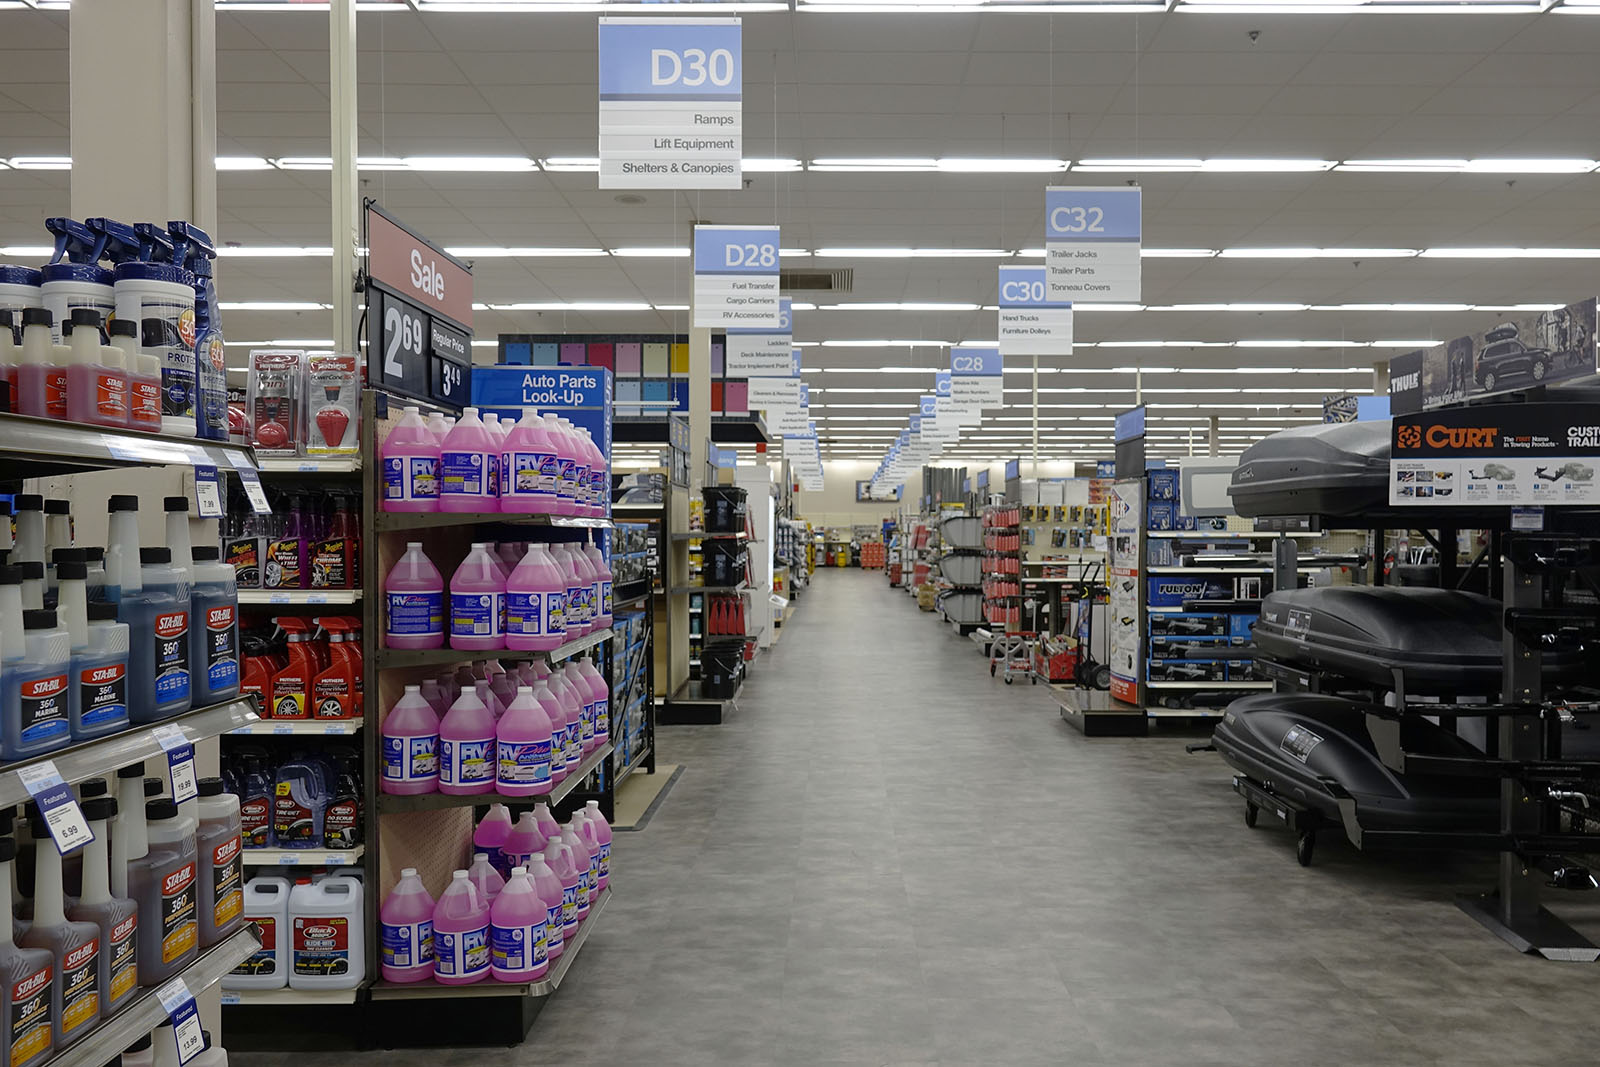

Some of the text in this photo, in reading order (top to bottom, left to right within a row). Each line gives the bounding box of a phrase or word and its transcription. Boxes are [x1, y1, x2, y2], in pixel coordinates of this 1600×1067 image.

[651, 49, 734, 86] D30
[694, 114, 734, 126] Ramps
[654, 139, 734, 150] Lift Equipment
[622, 163, 734, 175] Shelters & Canopies
[1051, 207, 1104, 232] C32
[725, 244, 775, 267] D28
[410, 249, 444, 301] Sale
[1051, 267, 1095, 275] Trailer Parts
[1002, 281, 1044, 301] C30
[726, 297, 747, 305] Cargo
[433, 329, 464, 353] Regular Price
[953, 357, 983, 372] C28
[522, 374, 596, 388] Auto Parts
[1391, 372, 1419, 393] THULE
[522, 389, 584, 406] Look-Up
[1425, 425, 1497, 448] CURT
[1567, 426, 1600, 437] CUST
[516, 455, 543, 470] RV
[1159, 584, 1202, 594] FULTON
[392, 596, 407, 605] RV
[159, 615, 184, 630] STA-BIL
[210, 608, 231, 622] STA-BIL
[215, 633, 227, 646] 360
[163, 641, 179, 655] 360
[92, 667, 117, 682] STA-BIL
[33, 679, 60, 694] STA-BIL
[99, 686, 112, 695] 360
[40, 698, 55, 709] 360
[94, 693, 116, 703] MARINE
[35, 706, 59, 718] MARINE
[412, 739, 434, 755] RV
[461, 744, 488, 760] RV
[499, 744, 521, 760] RV
[172, 750, 190, 760] Featured
[178, 780, 191, 791] 19.99
[43, 791, 68, 805] Featured
[61, 825, 79, 838] 6.99
[217, 838, 238, 860] STA-BIL
[166, 865, 191, 890] STA-BIL
[221, 864, 234, 881] 360
[171, 894, 188, 913] 360
[113, 917, 133, 939] STA-BIL
[464, 931, 488, 949] RV
[67, 941, 94, 967] STA-BIL
[116, 941, 130, 958] 360
[16, 970, 46, 998] STA-BIL
[71, 967, 88, 987] 360
[21, 998, 41, 1019] 360
[175, 1005, 194, 1021] Featured
[183, 1035, 198, 1050] 13.99
